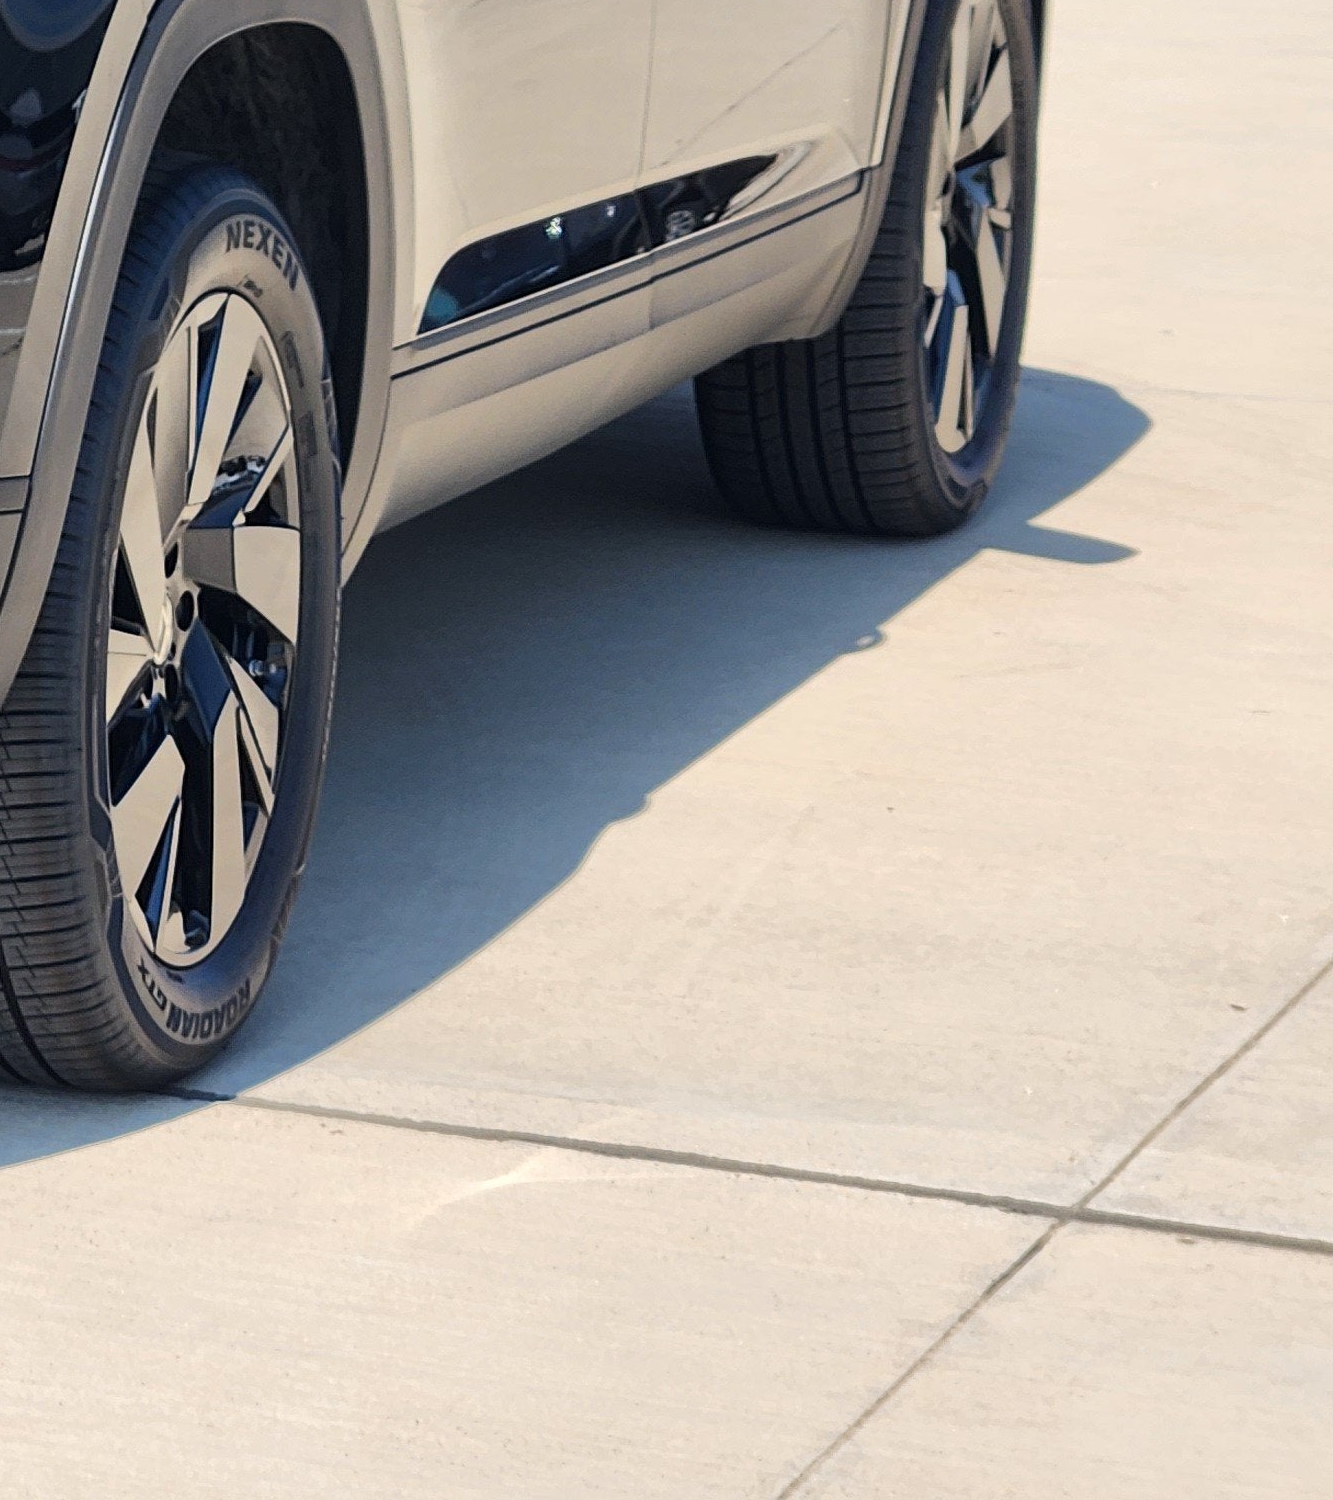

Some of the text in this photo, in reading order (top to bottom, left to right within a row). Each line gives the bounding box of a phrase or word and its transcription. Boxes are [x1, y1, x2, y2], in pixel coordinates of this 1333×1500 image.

[226, 220, 299, 291] NEXEN
[137, 958, 251, 1038] ROADIAN GTX
